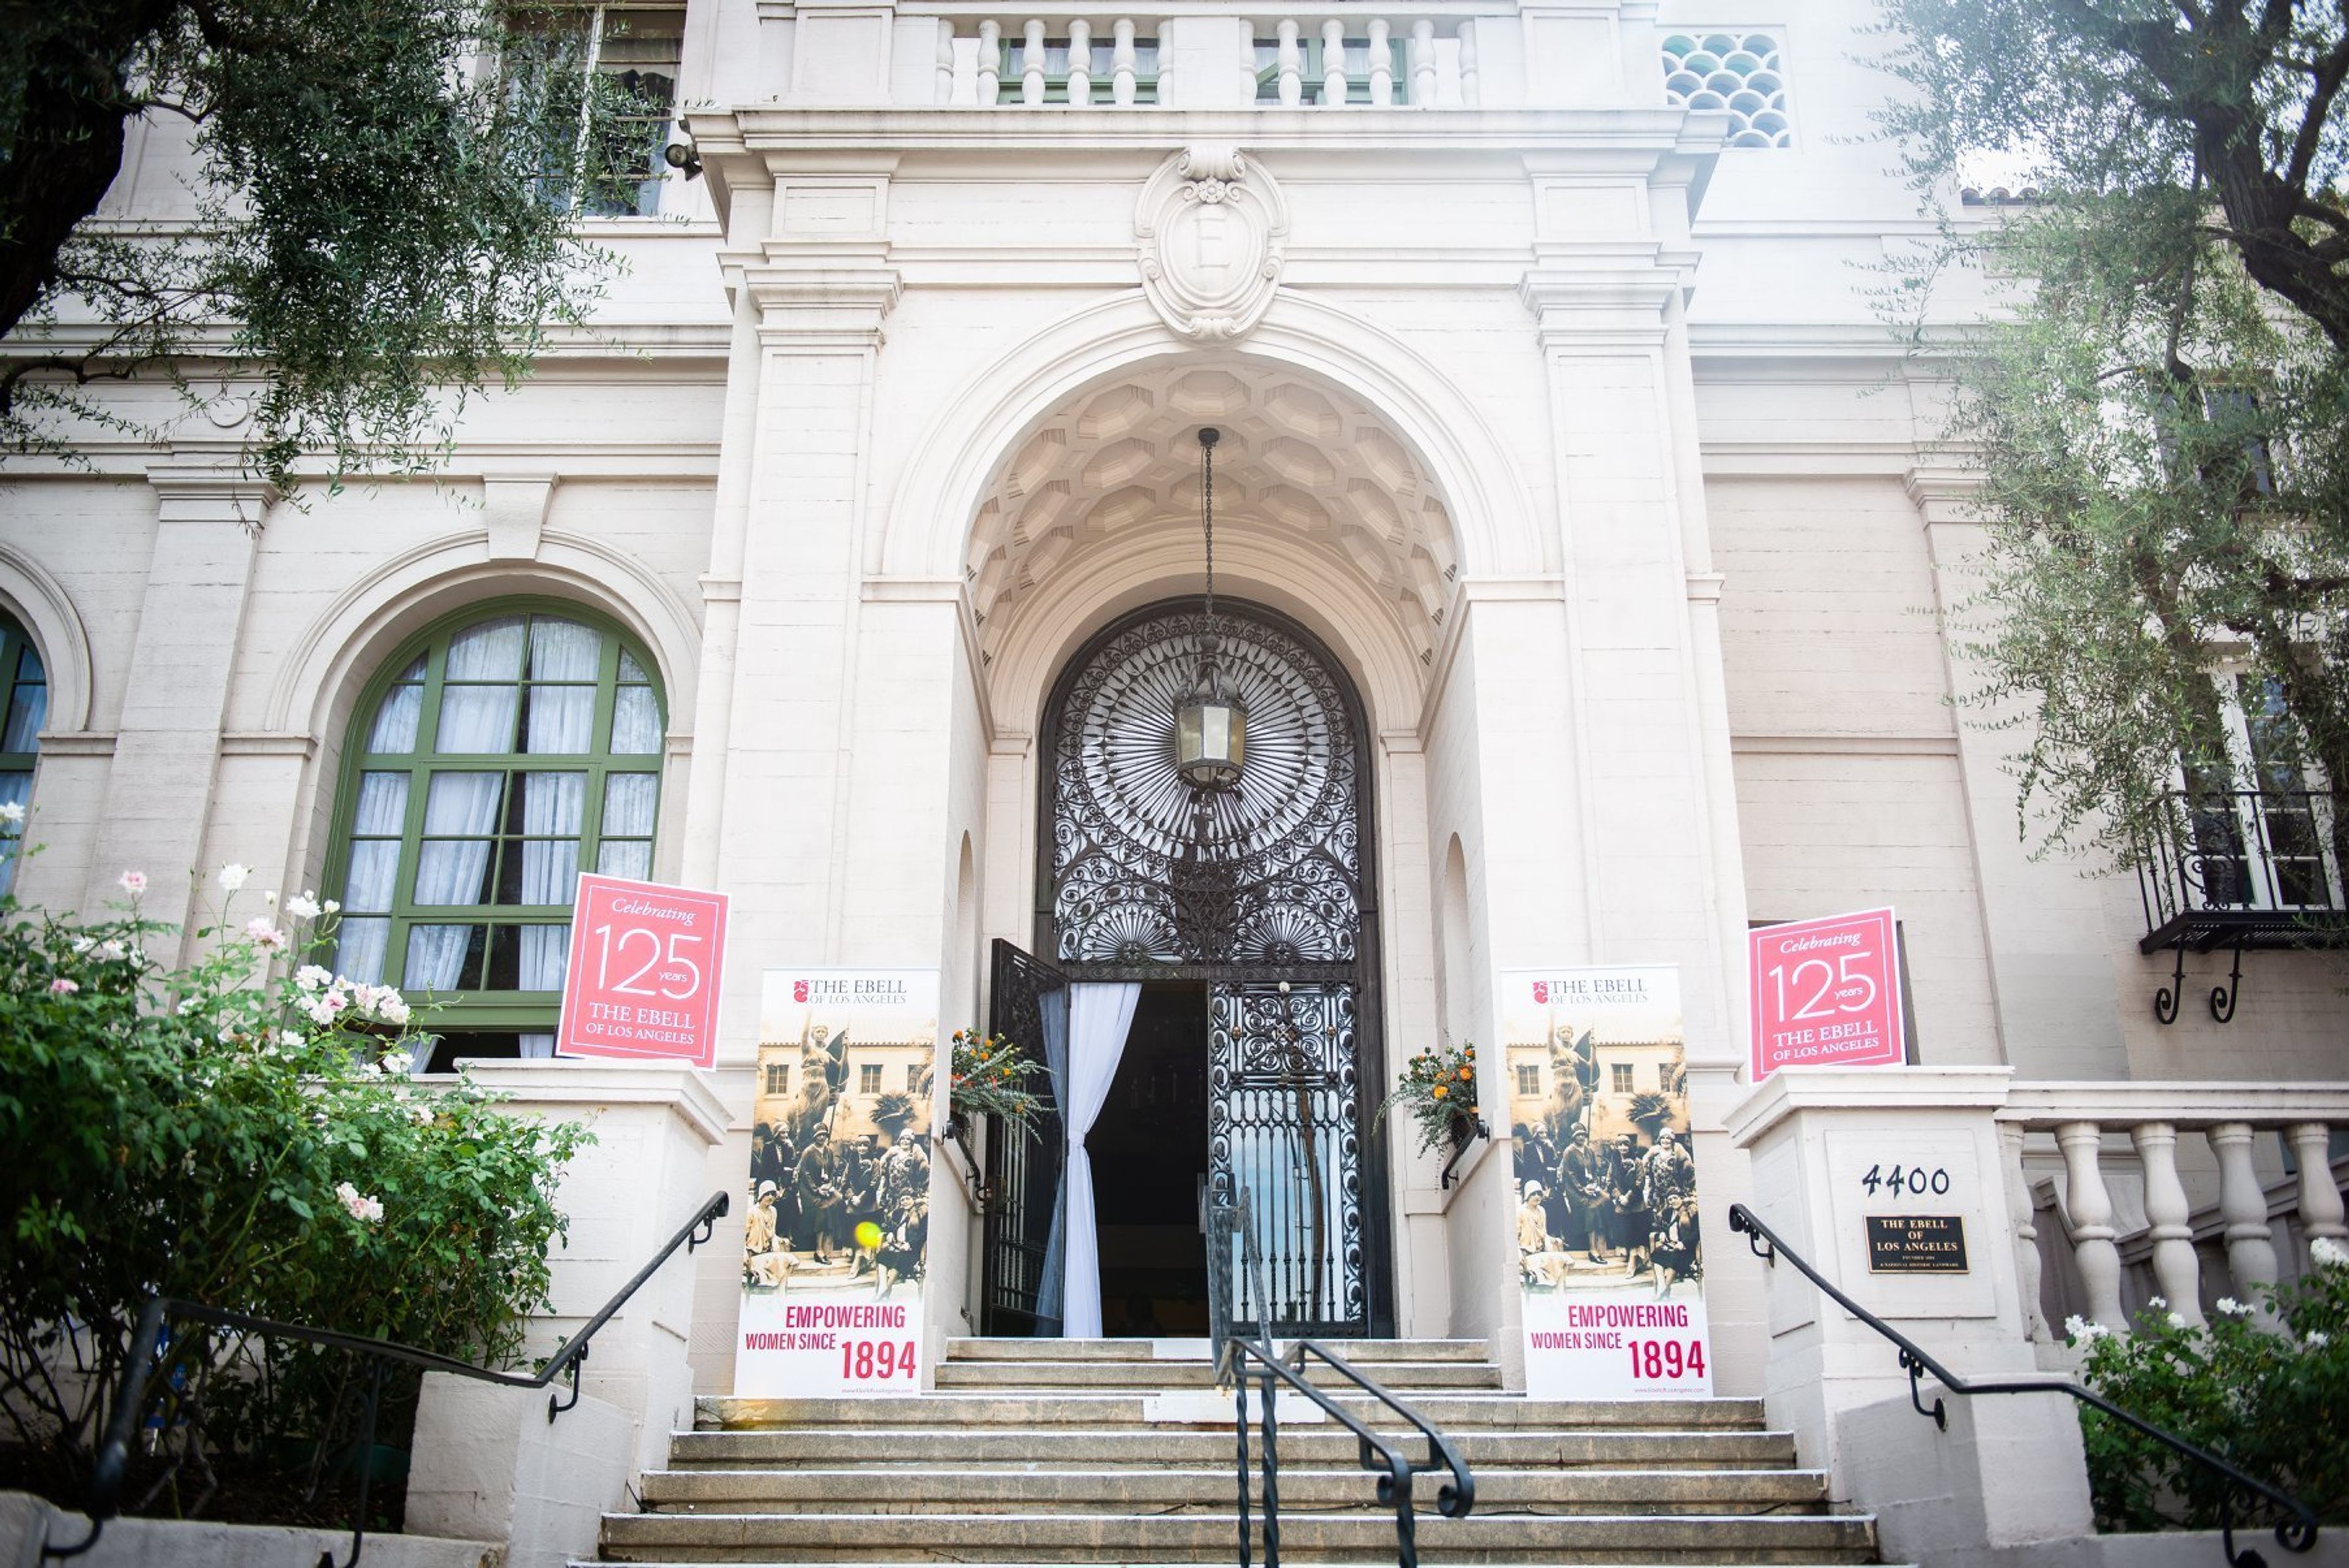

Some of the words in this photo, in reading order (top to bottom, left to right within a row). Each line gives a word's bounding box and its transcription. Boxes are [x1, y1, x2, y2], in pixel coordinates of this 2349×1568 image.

[612, 898, 696, 926] Celebrating
[1780, 933, 1861, 953] Celebrating
[595, 923, 702, 1000] 125
[659, 971, 688, 982] years
[811, 980, 848, 993] THE
[854, 980, 907, 993] EBELL
[1549, 980, 1588, 994] THE
[1594, 978, 1647, 993] EBELL
[1768, 951, 1876, 1023] 125
[809, 995, 826, 1004] OF
[829, 995, 850, 1004] LOS
[853, 995, 907, 1004] ANGELES
[1550, 995, 1567, 1004] OF
[1570, 994, 1591, 1004] LOS
[1593, 993, 1648, 1004] ANGELES
[1834, 987, 1863, 1000] years
[589, 1002, 632, 1022] THE
[636, 1008, 695, 1029] EBELL
[585, 1023, 604, 1035] OF
[607, 1024, 633, 1038] LOS
[636, 1029, 695, 1045] ANGELES
[1773, 1029, 1816, 1046] THE
[1819, 1020, 1878, 1040] EBELL
[1773, 1049, 1791, 1061] OF
[1794, 1045, 1818, 1059] LOS
[1820, 1037, 1879, 1054] ANGELES
[1862, 1164, 1949, 1199] 4400
[1881, 1220, 1906, 1229] THE
[1910, 1220, 1948, 1229] EBELL
[1907, 1231, 1924, 1240] OF
[1877, 1242, 1900, 1251] LOS
[1904, 1242, 1958, 1251] ANGELES
[786, 1306, 905, 1328] EMPOWERING
[1568, 1305, 1688, 1327] EMPOWERING
[746, 1333, 795, 1350] WOMEN
[799, 1333, 836, 1350] SINCE
[842, 1341, 916, 1378] 1894
[1531, 1332, 1581, 1348] WOMEN
[1585, 1332, 1622, 1348] SINCE
[1628, 1341, 1705, 1378] 1894
